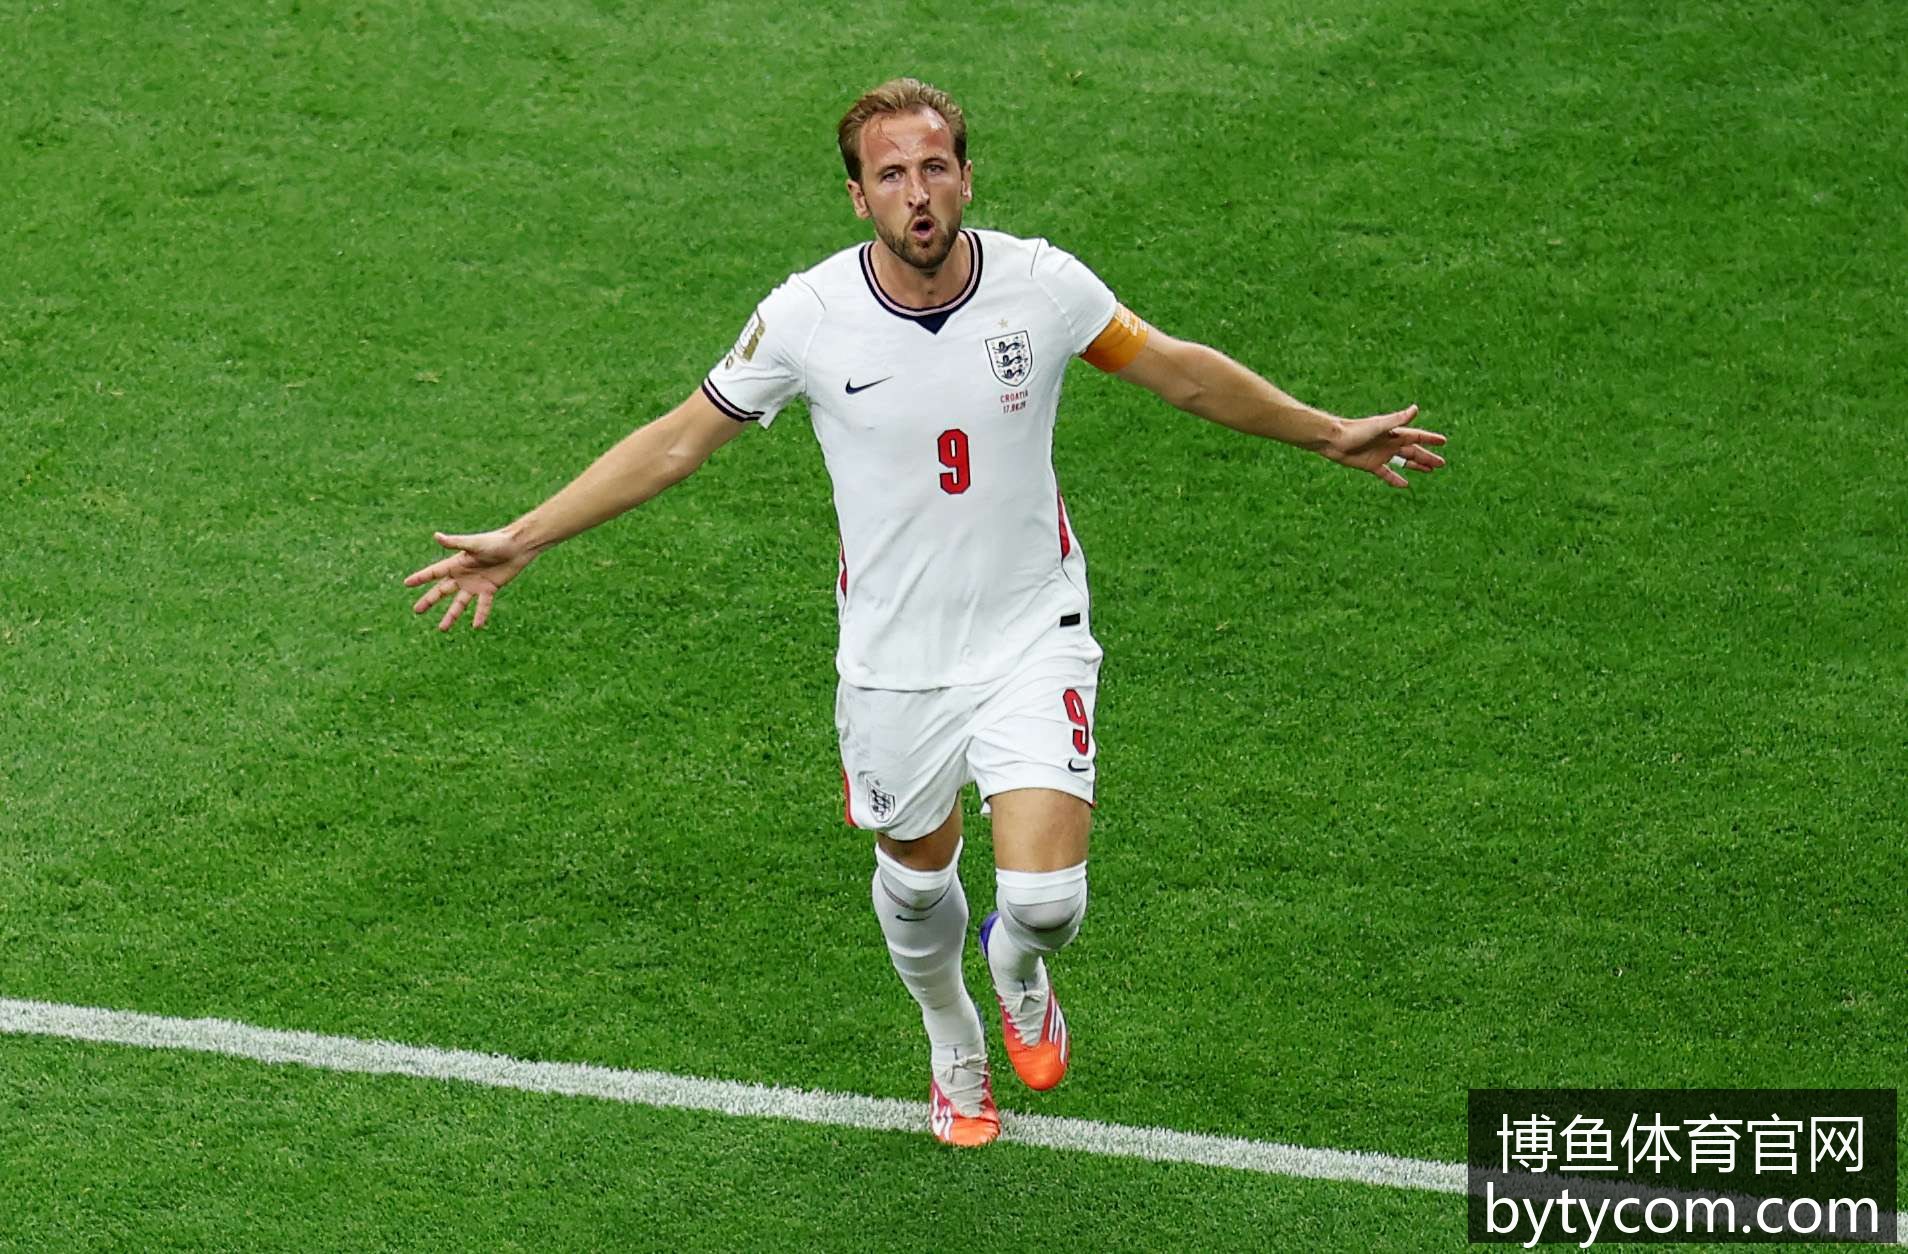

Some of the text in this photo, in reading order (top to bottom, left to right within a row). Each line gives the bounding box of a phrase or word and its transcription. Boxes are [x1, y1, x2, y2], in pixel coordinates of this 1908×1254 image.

[1000, 389, 1028, 403] CROATIA
[937, 428, 971, 495] 9
[1062, 688, 1090, 756] 9
